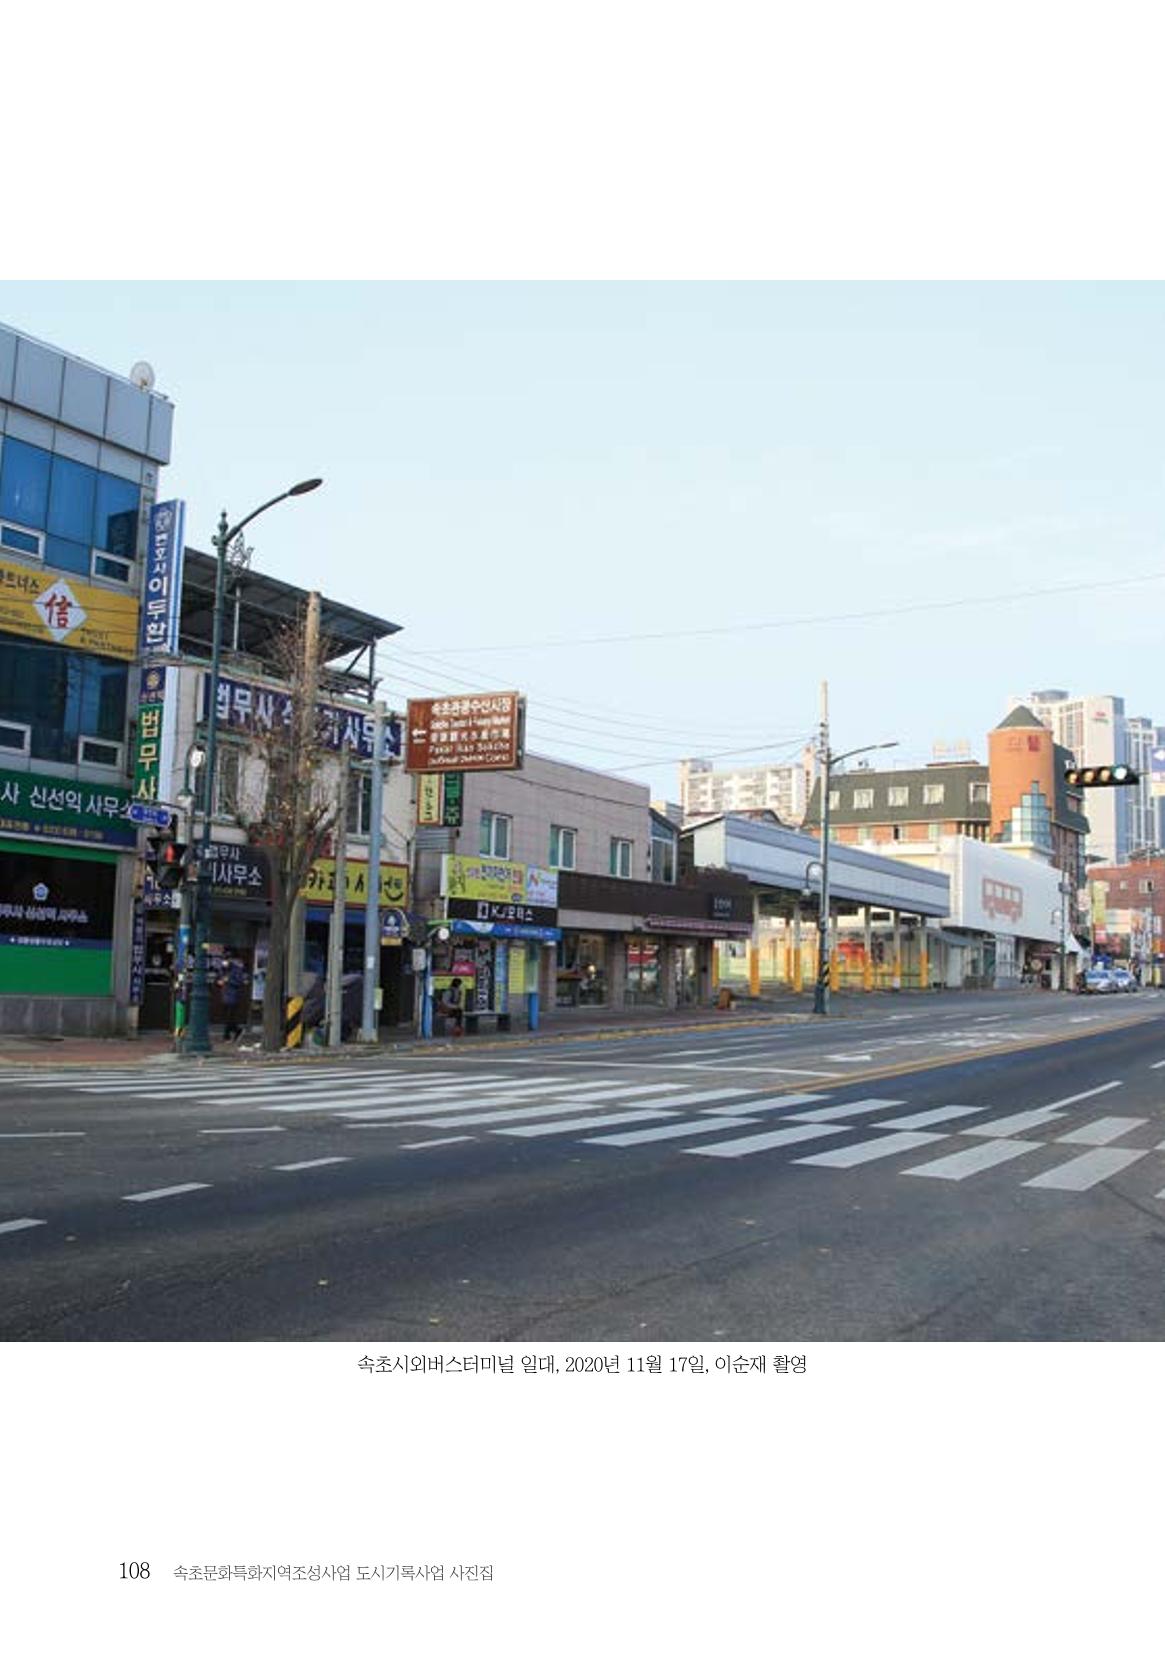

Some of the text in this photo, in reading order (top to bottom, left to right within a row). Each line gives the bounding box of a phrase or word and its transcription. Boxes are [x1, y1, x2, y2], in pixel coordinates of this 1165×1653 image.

[45, 592, 72, 628] 信
[147, 576, 169, 643] 이두환
[138, 710, 161, 800] 법무사
[29, 785, 82, 813] 신선익
